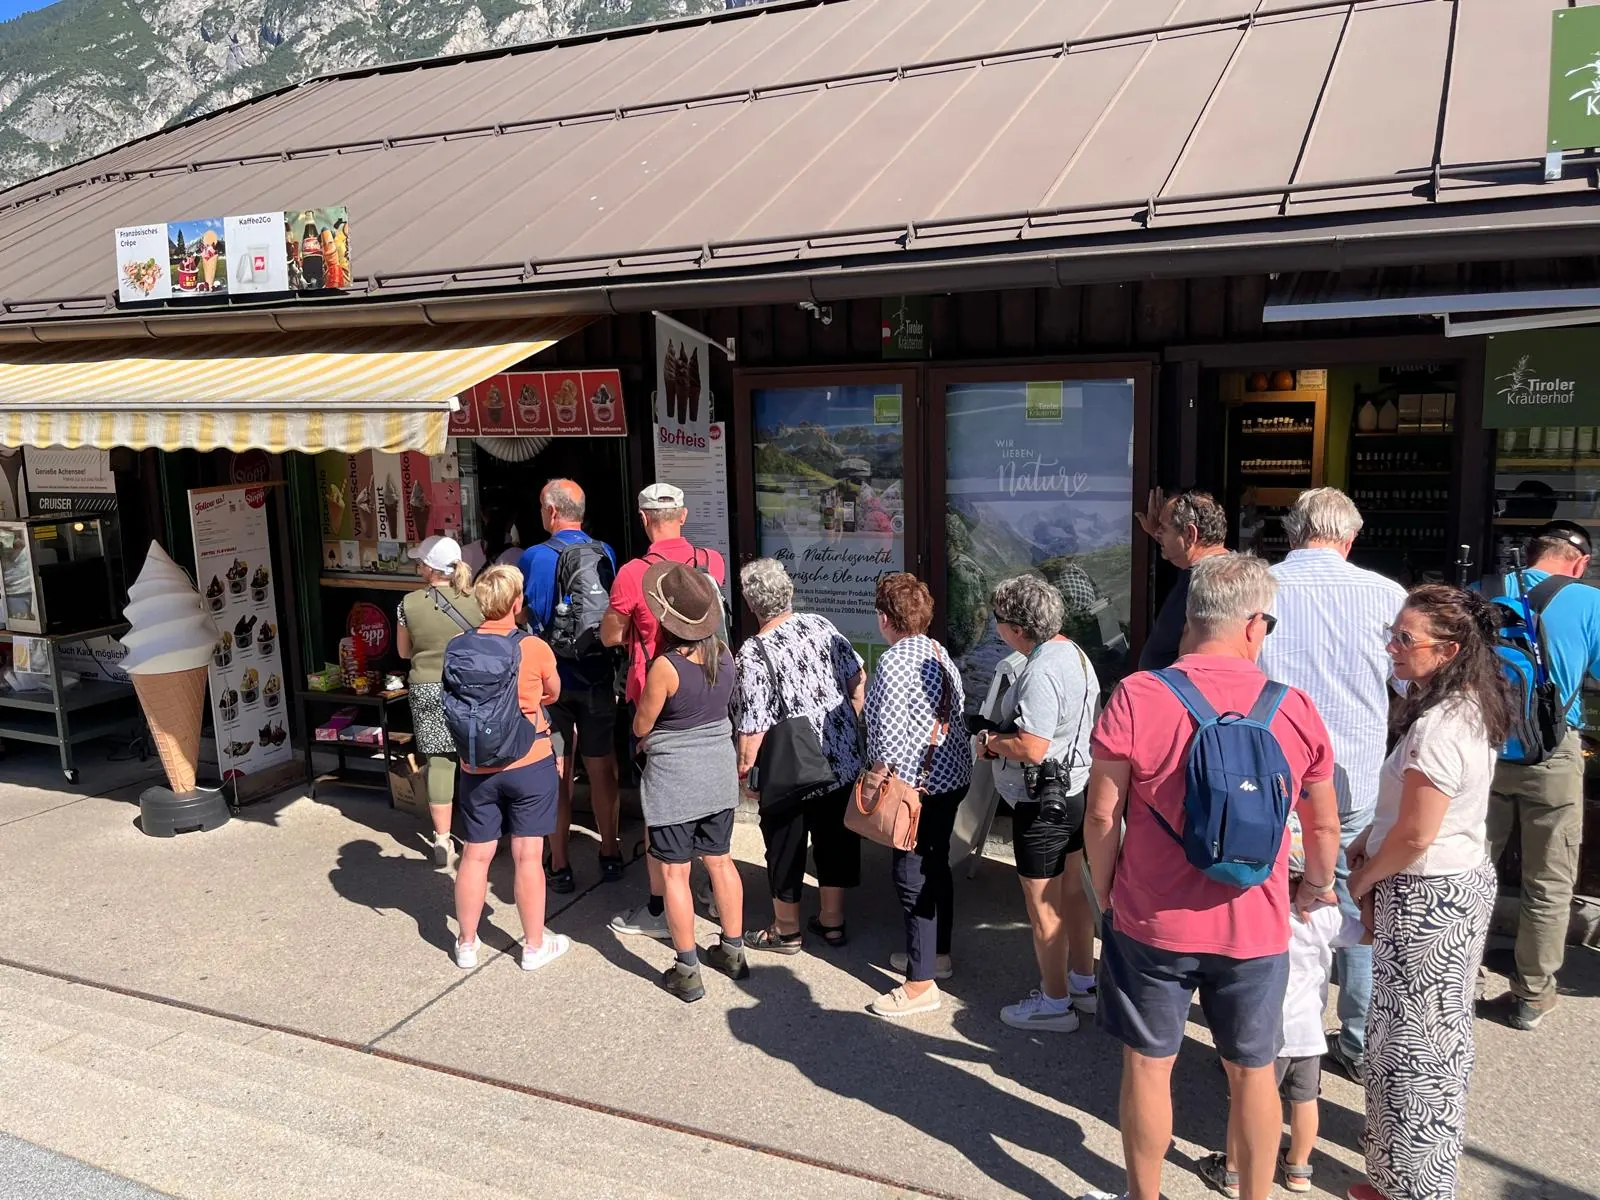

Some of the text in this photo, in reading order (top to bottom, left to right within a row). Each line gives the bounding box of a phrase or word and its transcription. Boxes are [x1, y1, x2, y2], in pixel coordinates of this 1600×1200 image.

[239, 216, 271, 225] Kaffee2Go
[121, 239, 137, 248] Crêpe
[1527, 377, 1576, 391] Tiroler
[1507, 391, 1575, 405] Kräuterhof
[659, 427, 706, 449] Softeis
[995, 439, 1015, 448] WIR
[1002, 448, 1034, 458] LIEBEN
[996, 454, 1074, 498] Natur
[401, 450, 415, 541] ErdbeerKoko
[39, 497, 72, 510] CRUISER
[195, 500, 214, 516] Follow
[376, 485, 388, 538] Joghurt
[831, 566, 852, 583] Öle
[855, 570, 882, 584] und
